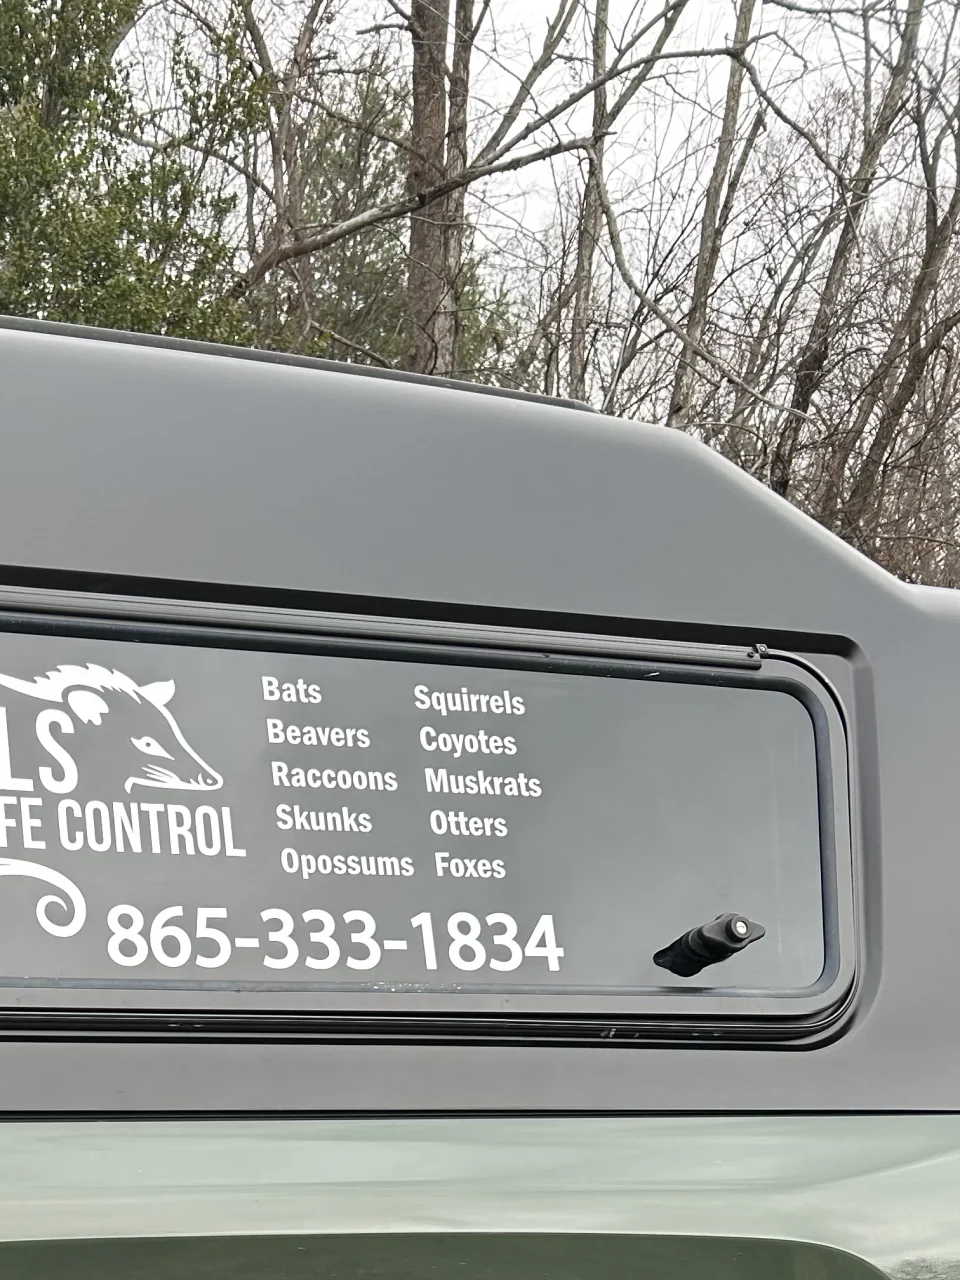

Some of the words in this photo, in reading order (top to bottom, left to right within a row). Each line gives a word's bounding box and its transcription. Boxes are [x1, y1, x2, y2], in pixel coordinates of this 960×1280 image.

[261, 675, 322, 704] Bats
[413, 684, 526, 717] Squirrels
[266, 718, 371, 748] Beavers
[419, 726, 518, 758] Coyotes
[271, 761, 398, 792] Raccoons
[424, 767, 542, 798] Muskrats
[57, 798, 247, 858] CONTROL
[275, 803, 373, 833] Skunks
[429, 809, 508, 837] Otters
[280, 847, 415, 880] Opossums
[434, 851, 506, 879] Foxes
[106, 903, 565, 972] 865-333-1834
